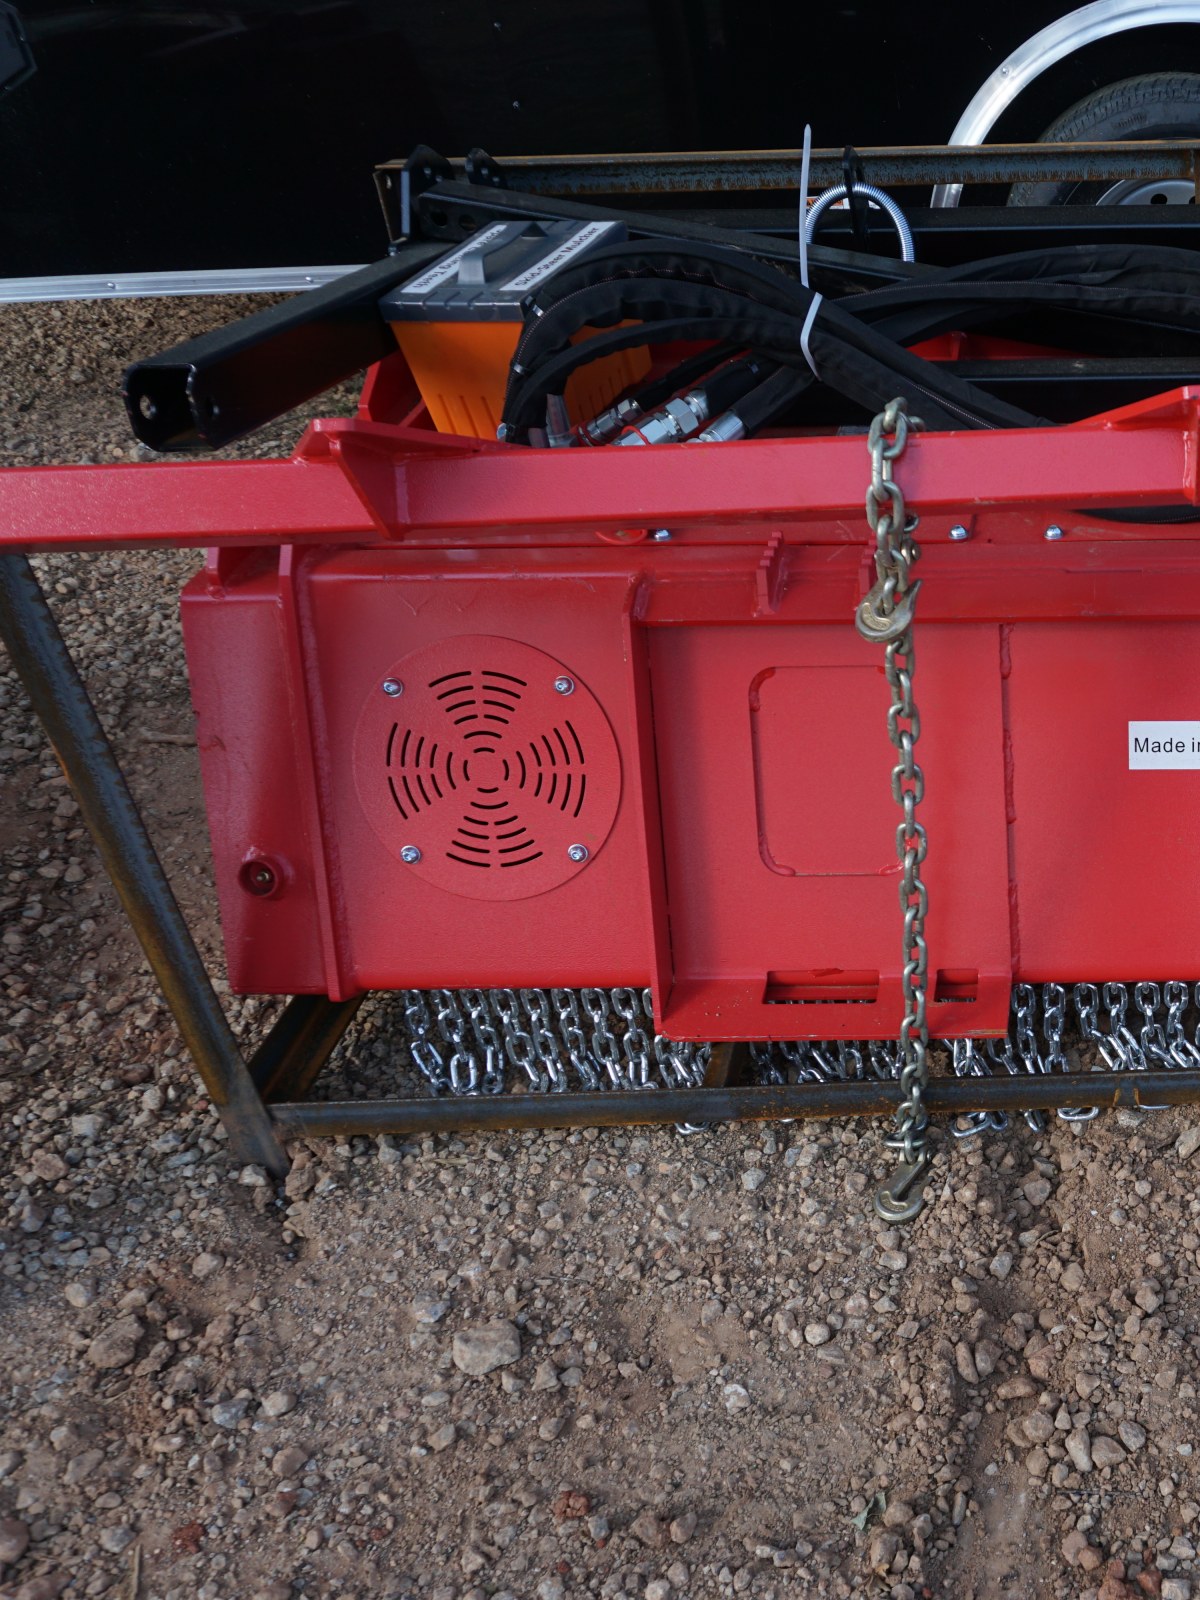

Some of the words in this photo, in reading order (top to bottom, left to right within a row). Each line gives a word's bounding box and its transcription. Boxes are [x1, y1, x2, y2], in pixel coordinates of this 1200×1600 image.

[513, 253, 566, 287] Skid-Steer
[559, 226, 600, 254] Mulcher
[413, 268, 447, 288] Teeth
[1134, 737, 1186, 753] Made
